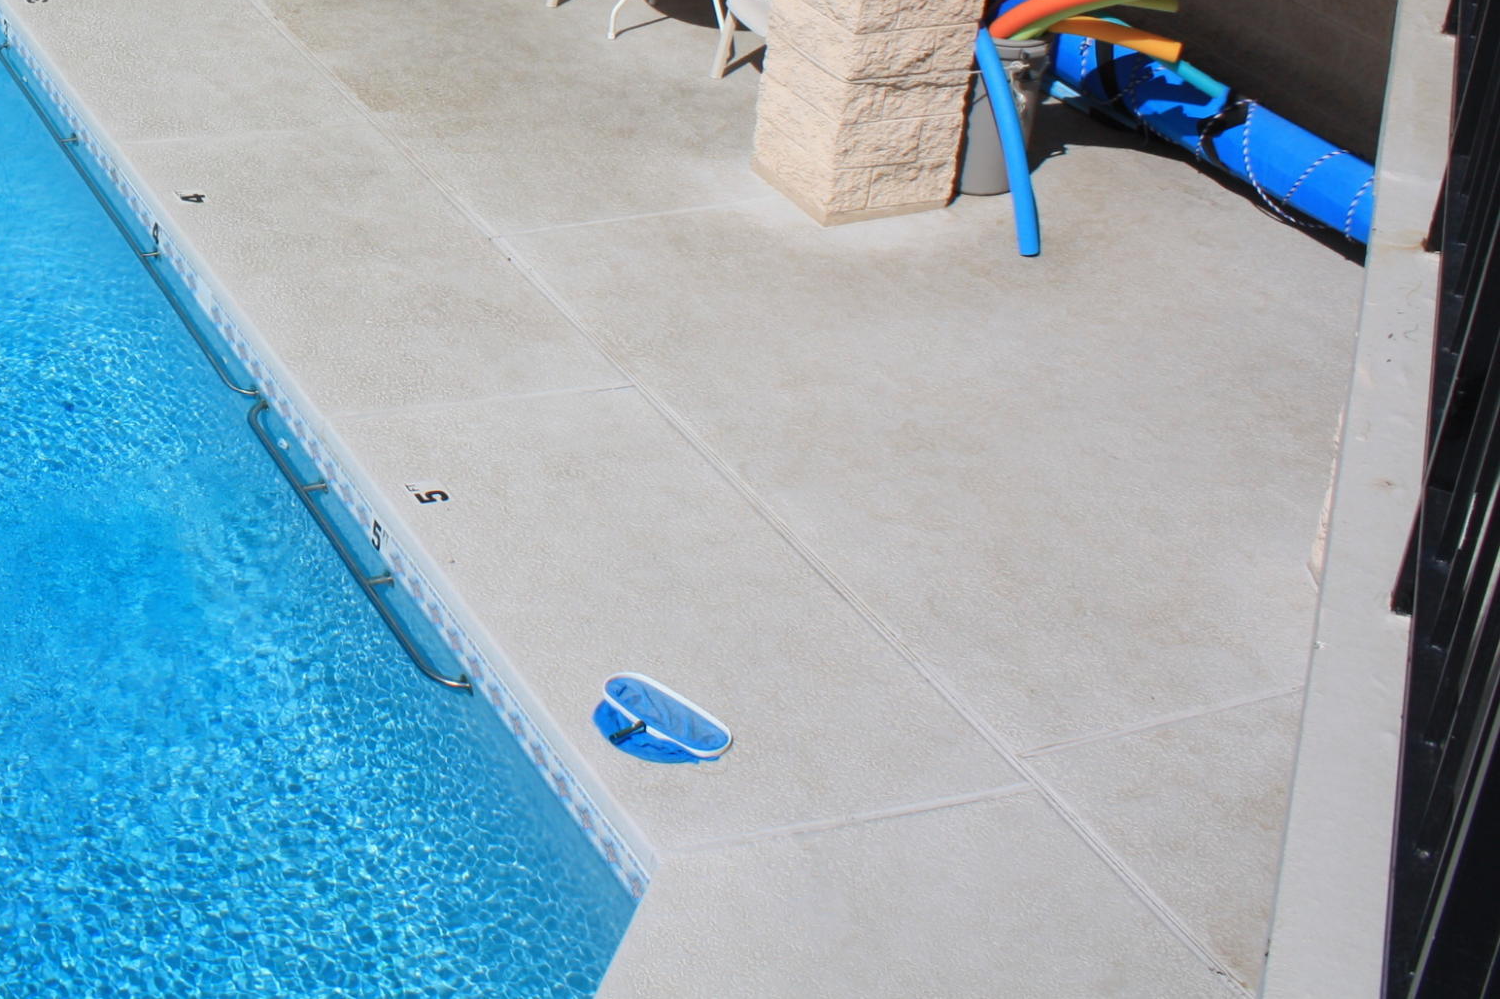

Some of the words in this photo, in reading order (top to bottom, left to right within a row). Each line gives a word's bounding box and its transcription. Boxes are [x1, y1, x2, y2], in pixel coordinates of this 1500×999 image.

[180, 193, 206, 203] 4
[414, 489, 450, 504] 5
[371, 519, 382, 552] 5
